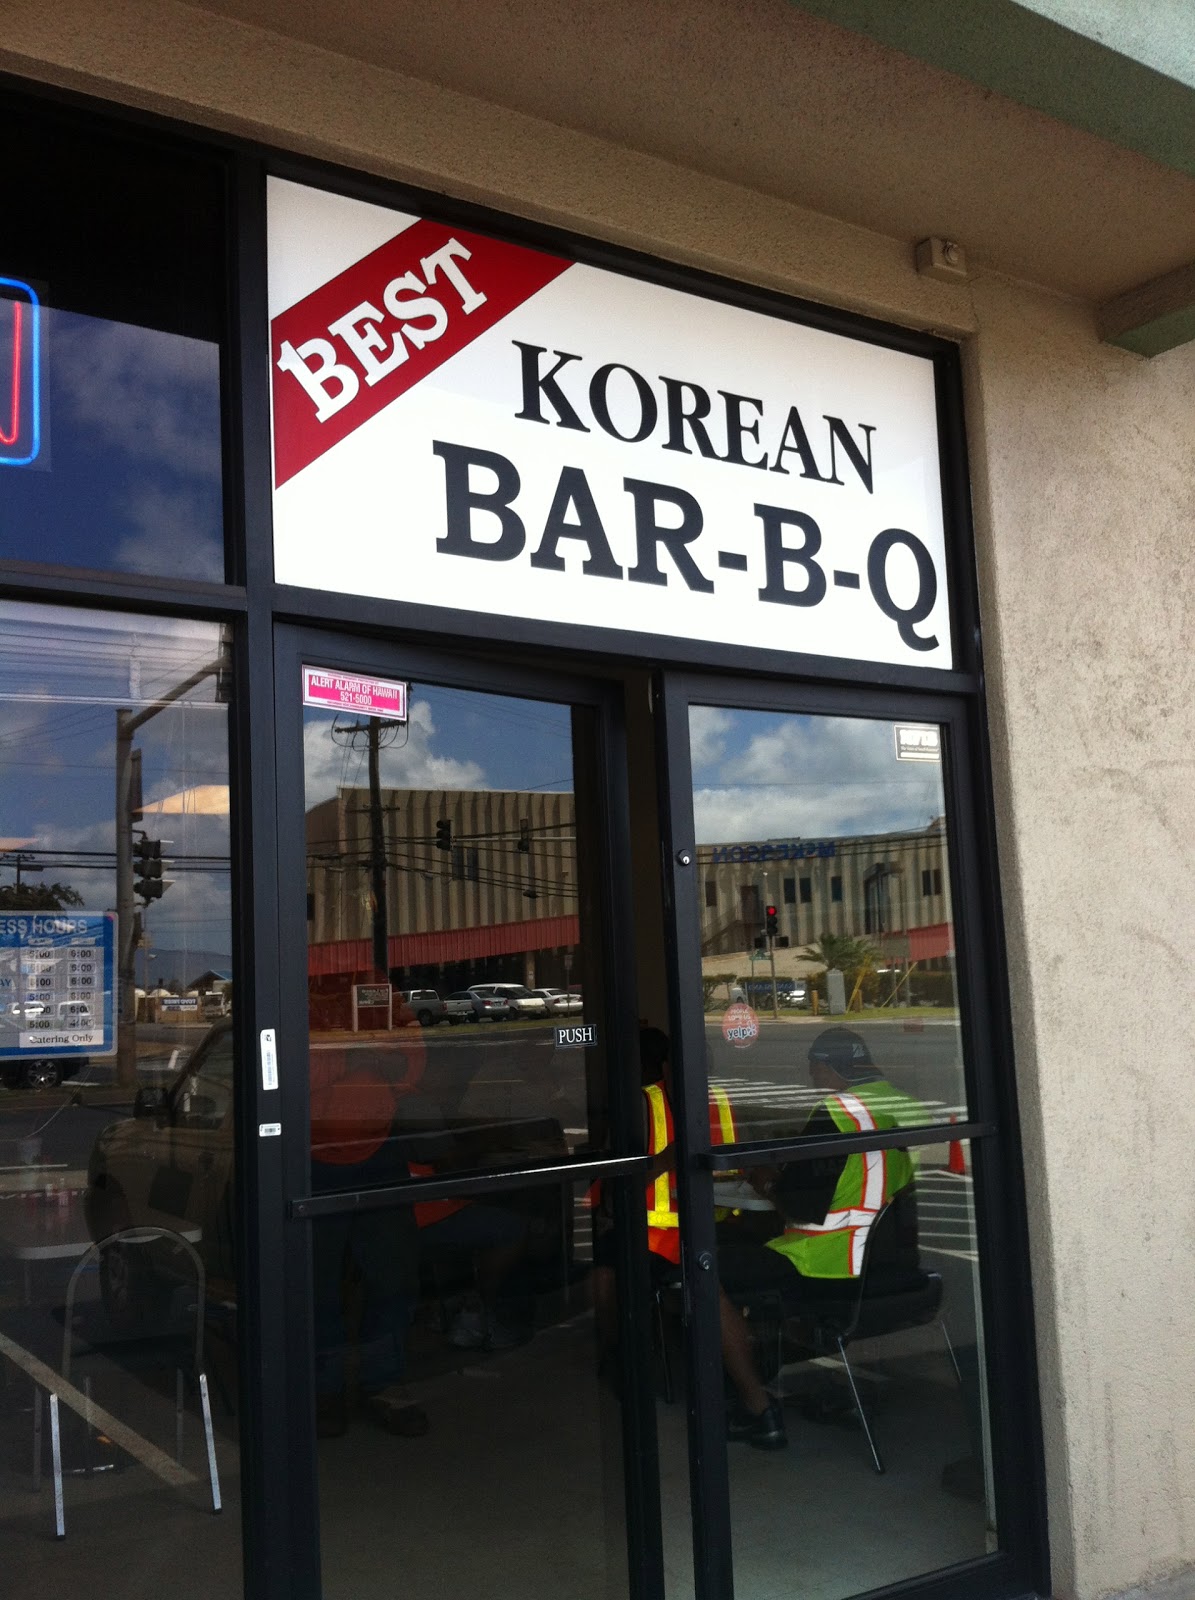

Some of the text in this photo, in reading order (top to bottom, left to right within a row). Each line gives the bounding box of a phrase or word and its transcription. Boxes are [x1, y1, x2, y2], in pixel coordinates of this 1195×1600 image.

[277, 237, 488, 424] BEST
[512, 340, 877, 495] KOREAN
[432, 439, 940, 652] BAR-B-Q
[311, 675, 334, 689] ALERT
[335, 680, 361, 693] ALARM
[361, 684, 372, 695] OF
[372, 686, 398, 699] HAWAII
[340, 691, 372, 705] 521-5000
[33, 919, 87, 934] HOURS
[29, 993, 51, 1001] 5:00
[29, 1020, 50, 1029] 5:00
[30, 1033, 94, 1044] Catering Only
[558, 1027, 593, 1044] PUSH
[727, 1026, 749, 1040] yelp
